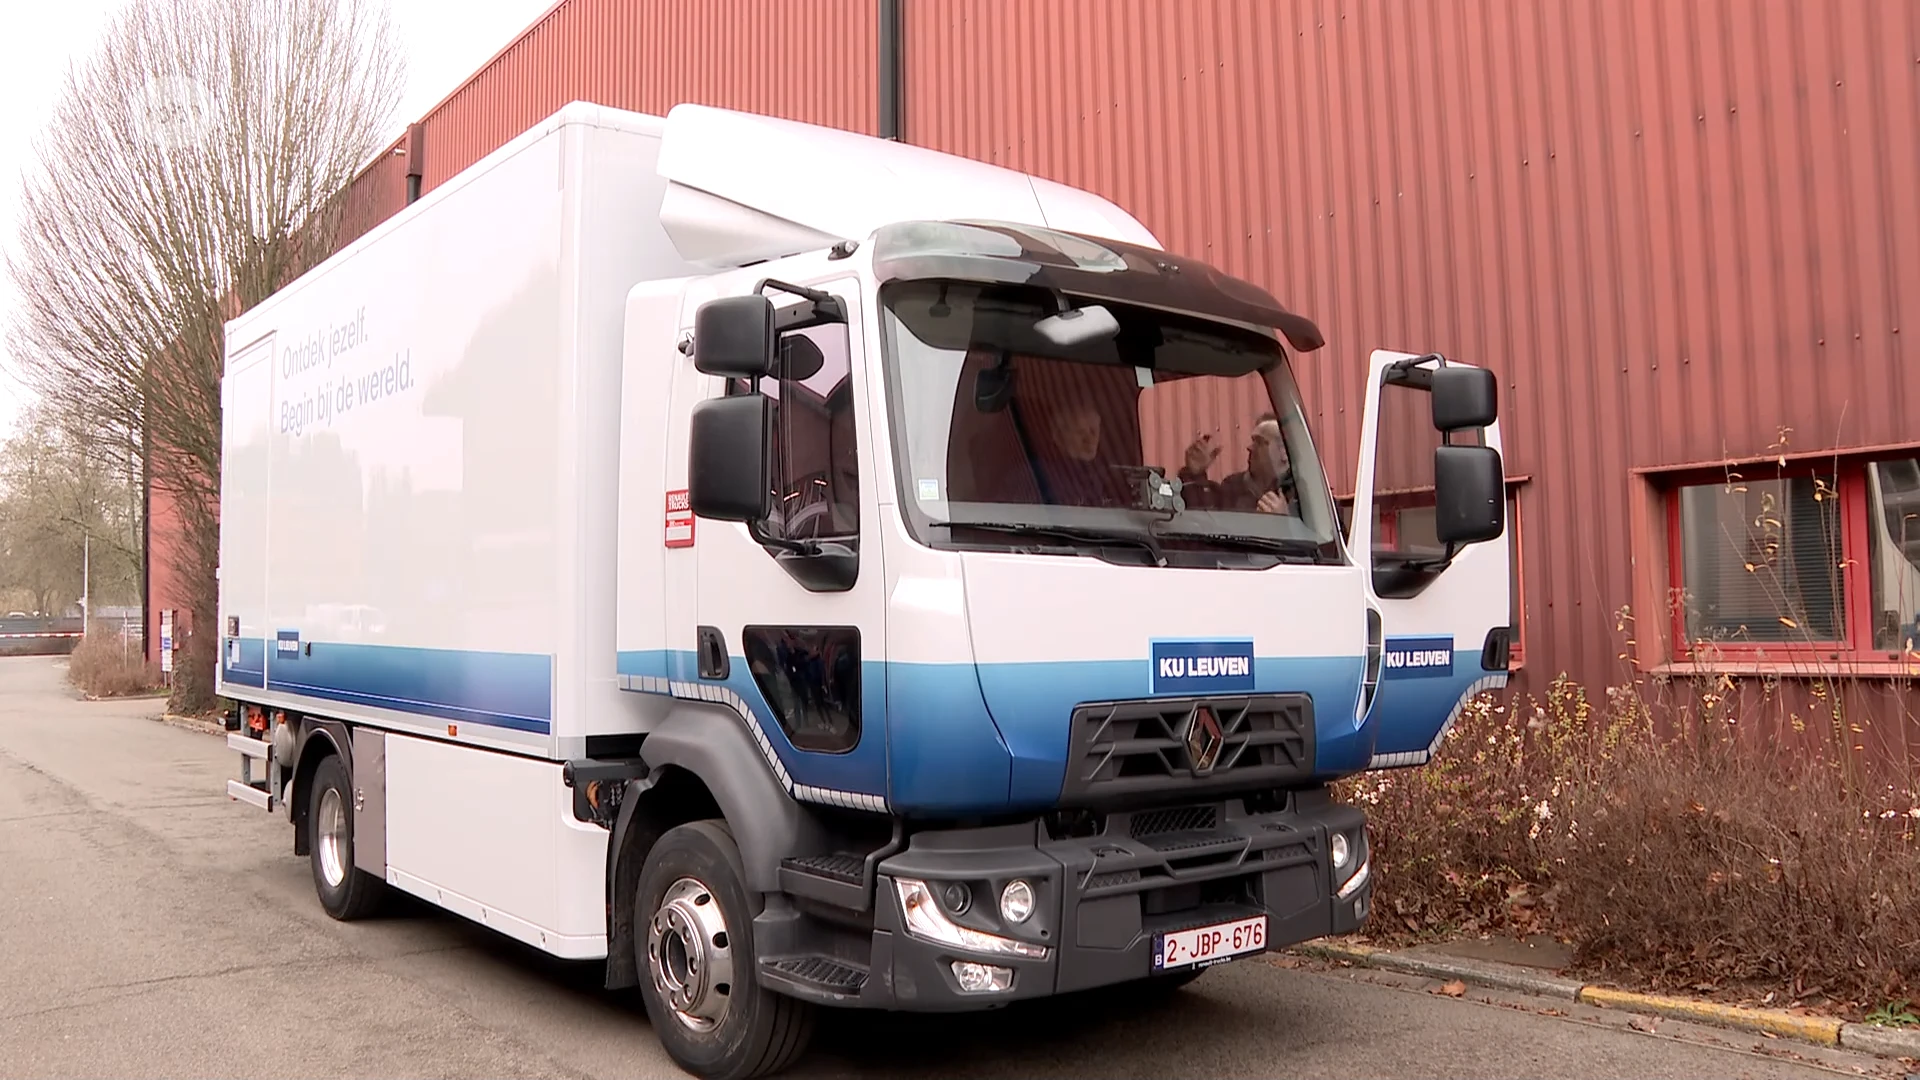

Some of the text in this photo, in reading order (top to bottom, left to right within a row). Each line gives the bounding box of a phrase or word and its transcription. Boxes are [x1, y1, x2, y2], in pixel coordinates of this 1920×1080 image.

[283, 306, 368, 380] Ontdek jezelf.
[281, 347, 414, 437] Begin bij de wereld.
[1160, 656, 1249, 678] KU LEUVEN
[1386, 650, 1450, 668] KU LEUVEN
[1155, 954, 1162, 966] B
